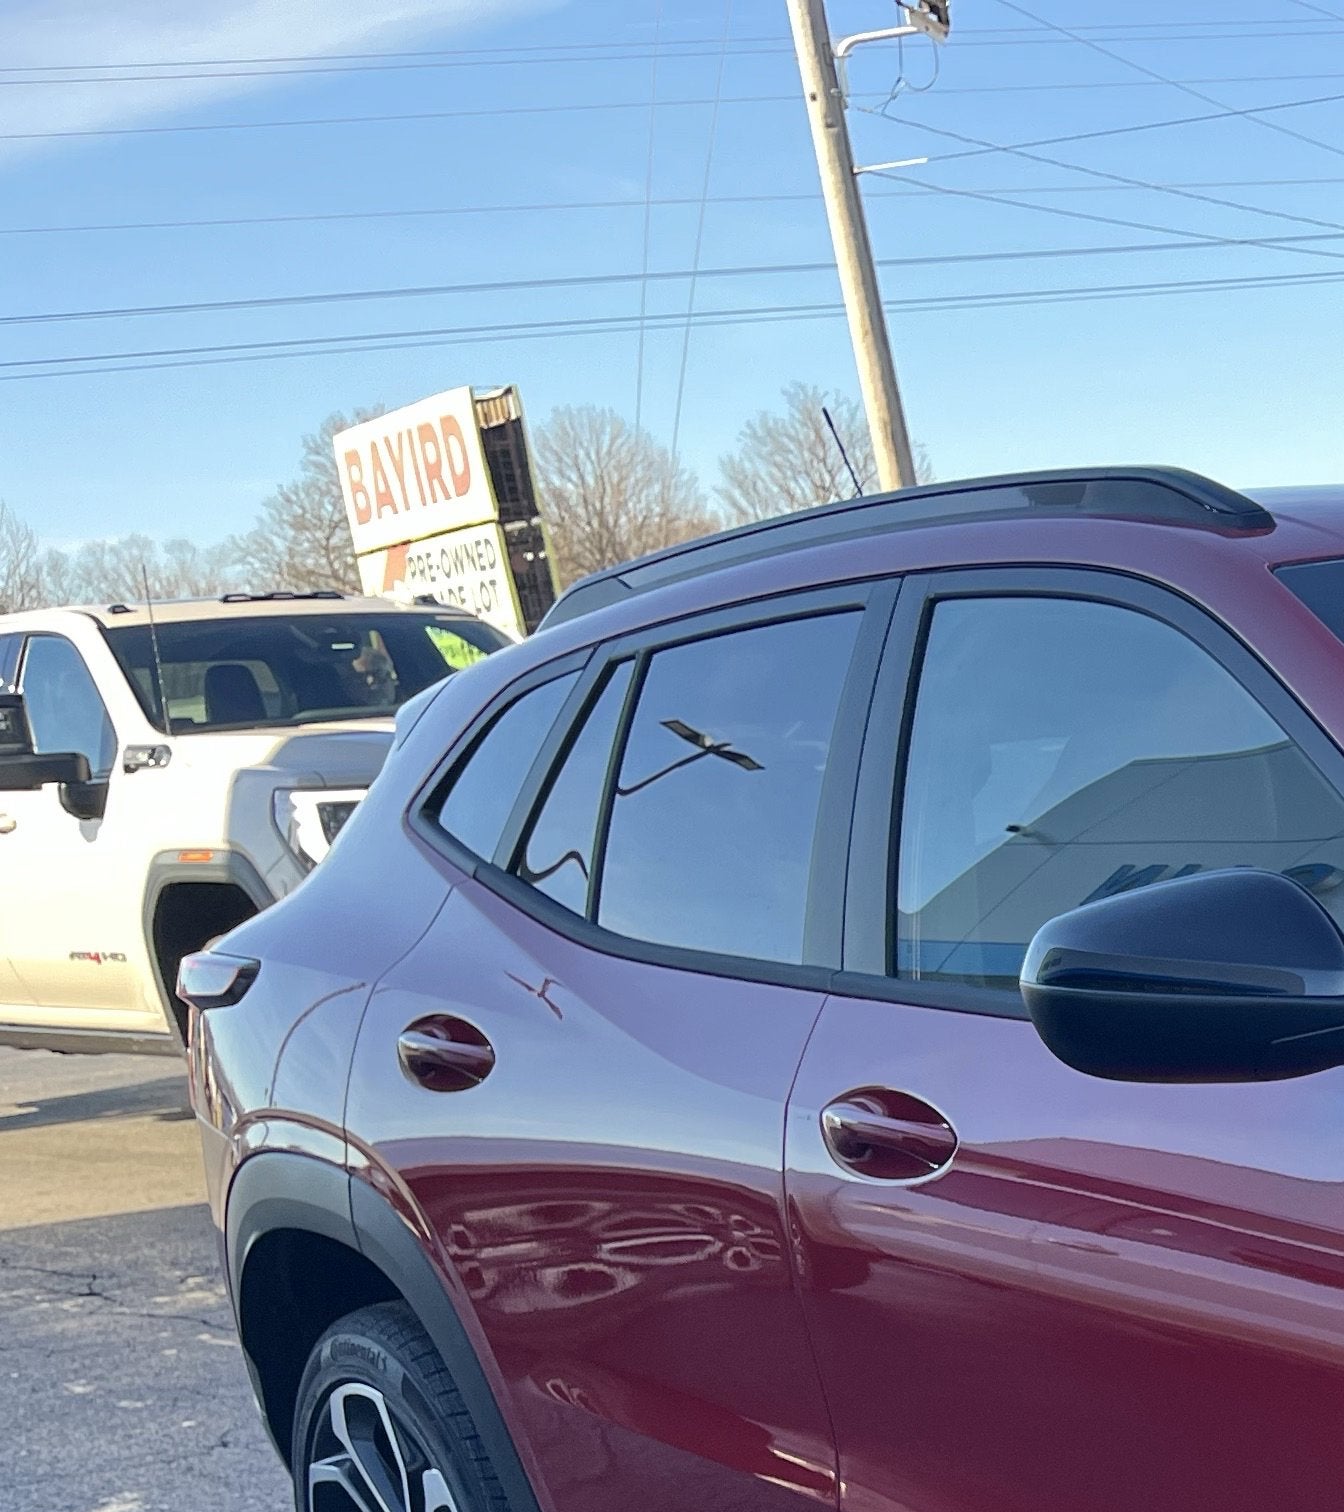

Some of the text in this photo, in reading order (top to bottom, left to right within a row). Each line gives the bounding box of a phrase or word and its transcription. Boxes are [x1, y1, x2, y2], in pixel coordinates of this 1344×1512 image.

[344, 414, 471, 526] BAYIRD
[408, 538, 496, 582] PRE-OWNED
[471, 579, 499, 613] LOT
